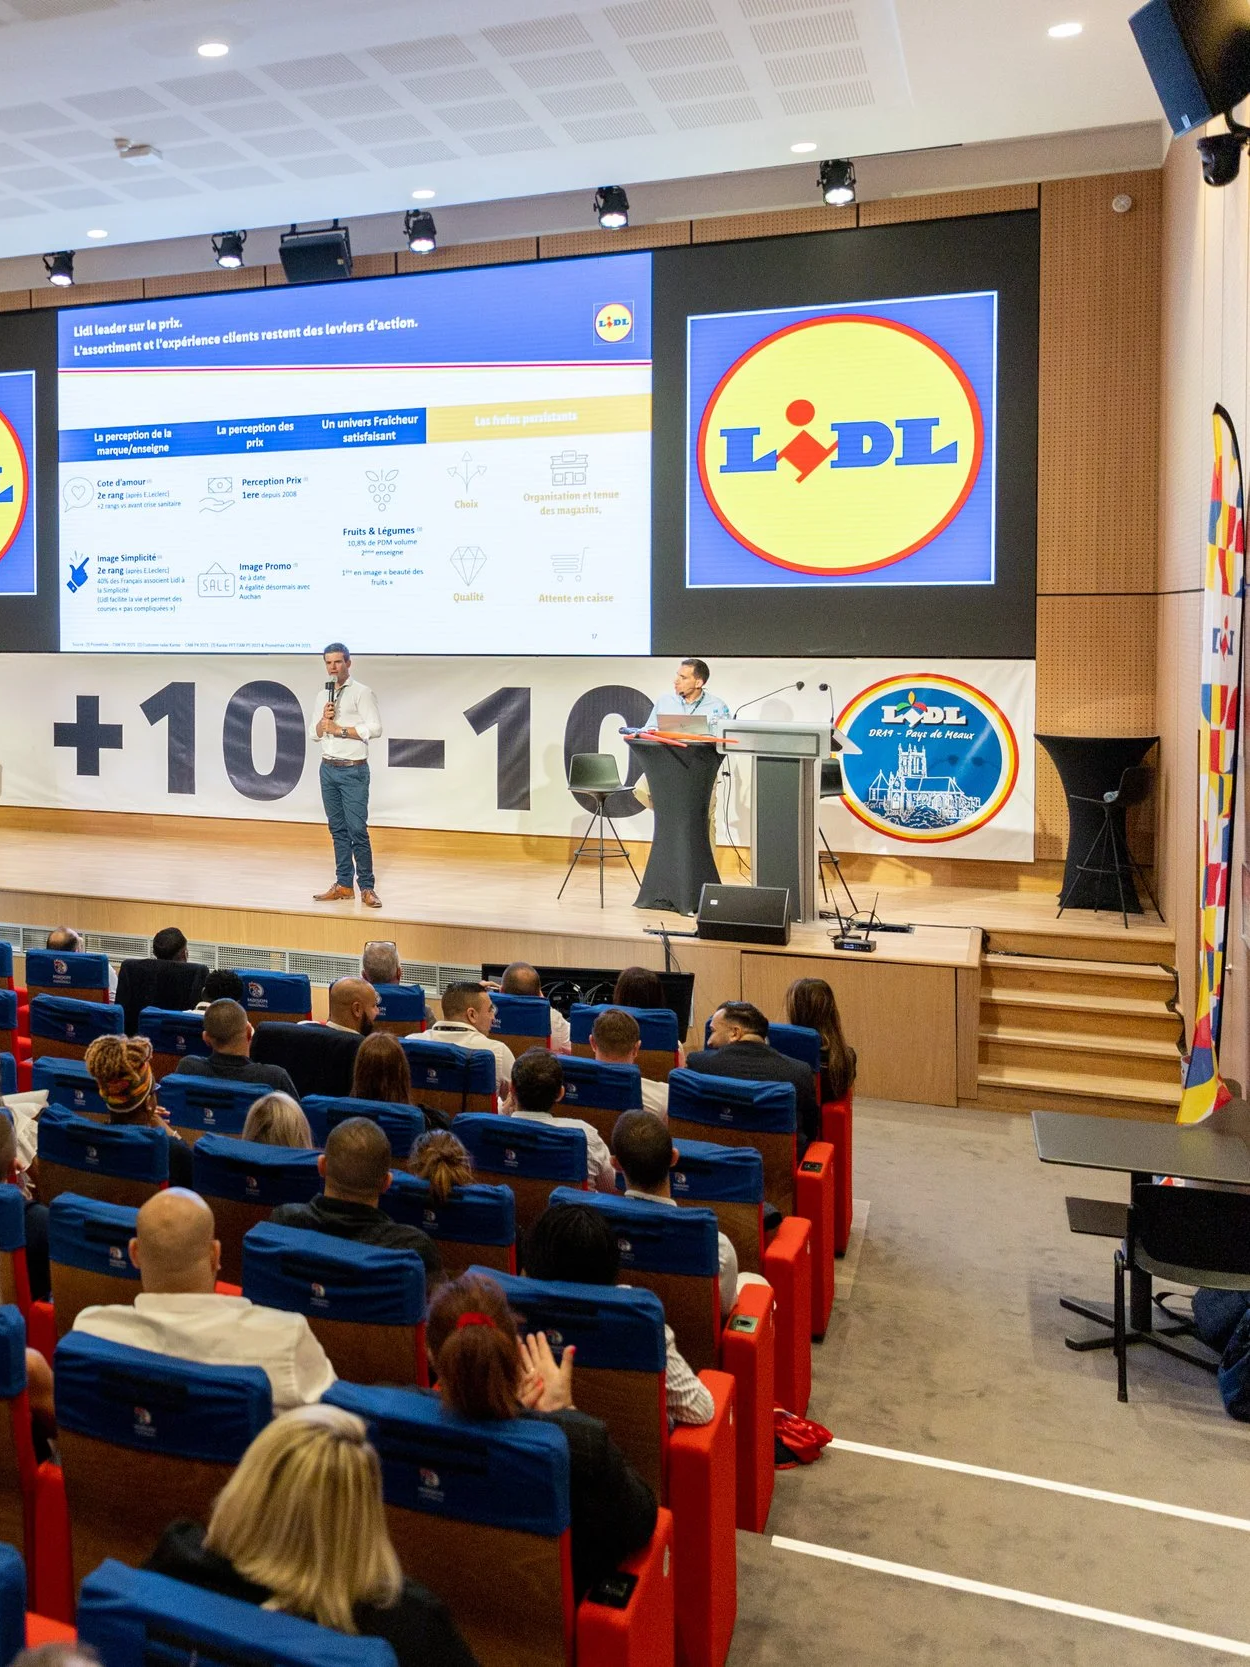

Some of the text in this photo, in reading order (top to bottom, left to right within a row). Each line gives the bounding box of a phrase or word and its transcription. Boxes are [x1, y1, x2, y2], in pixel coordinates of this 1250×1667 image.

[74, 317, 182, 338] Lidl leader sur le prix.
[144, 340, 154, 351] et
[222, 332, 259, 344] clients
[261, 327, 301, 340] restent
[303, 326, 323, 337] des
[326, 322, 364, 335] leviers
[322, 415, 418, 429] Un univers Fraîcheur
[216, 422, 294, 436] La perception des
[94, 428, 172, 443] La perception de la
[342, 431, 396, 442] satisfaisant
[246, 438, 264, 449] prix
[97, 444, 169, 457] marque/enseigne
[97, 480, 114, 488] Cote
[242, 478, 284, 487] Perception
[286, 476, 302, 484] Prix
[97, 492, 106, 500] 2e
[108, 492, 124, 500] rang
[282, 490, 297, 498] 2008
[524, 491, 619, 504] Organisation et tenue
[158, 500, 182, 508] sanitaire
[454, 500, 478, 509] Choix
[540, 507, 555, 516] des
[343, 528, 366, 536] Fruits
[368, 527, 376, 535] &
[378, 526, 415, 536] Légumes
[97, 555, 119, 563] Image
[120, 553, 156, 562] Simplicité
[108, 567, 124, 576] rang
[126, 566, 142, 575] (après
[240, 563, 263, 572] Image
[265, 562, 292, 570] Promo
[103, 586, 129, 594] Simplicité
[202, 579, 230, 592] SALE
[245, 584, 264, 592] égalité
[453, 592, 484, 603] Qualité
[539, 594, 572, 603] Attente
[586, 593, 614, 602] caisse
[53, 680, 307, 802] +10
[906, 729, 927, 742] Pays
[930, 729, 942, 739] de
[944, 730, 975, 740] Meaux
